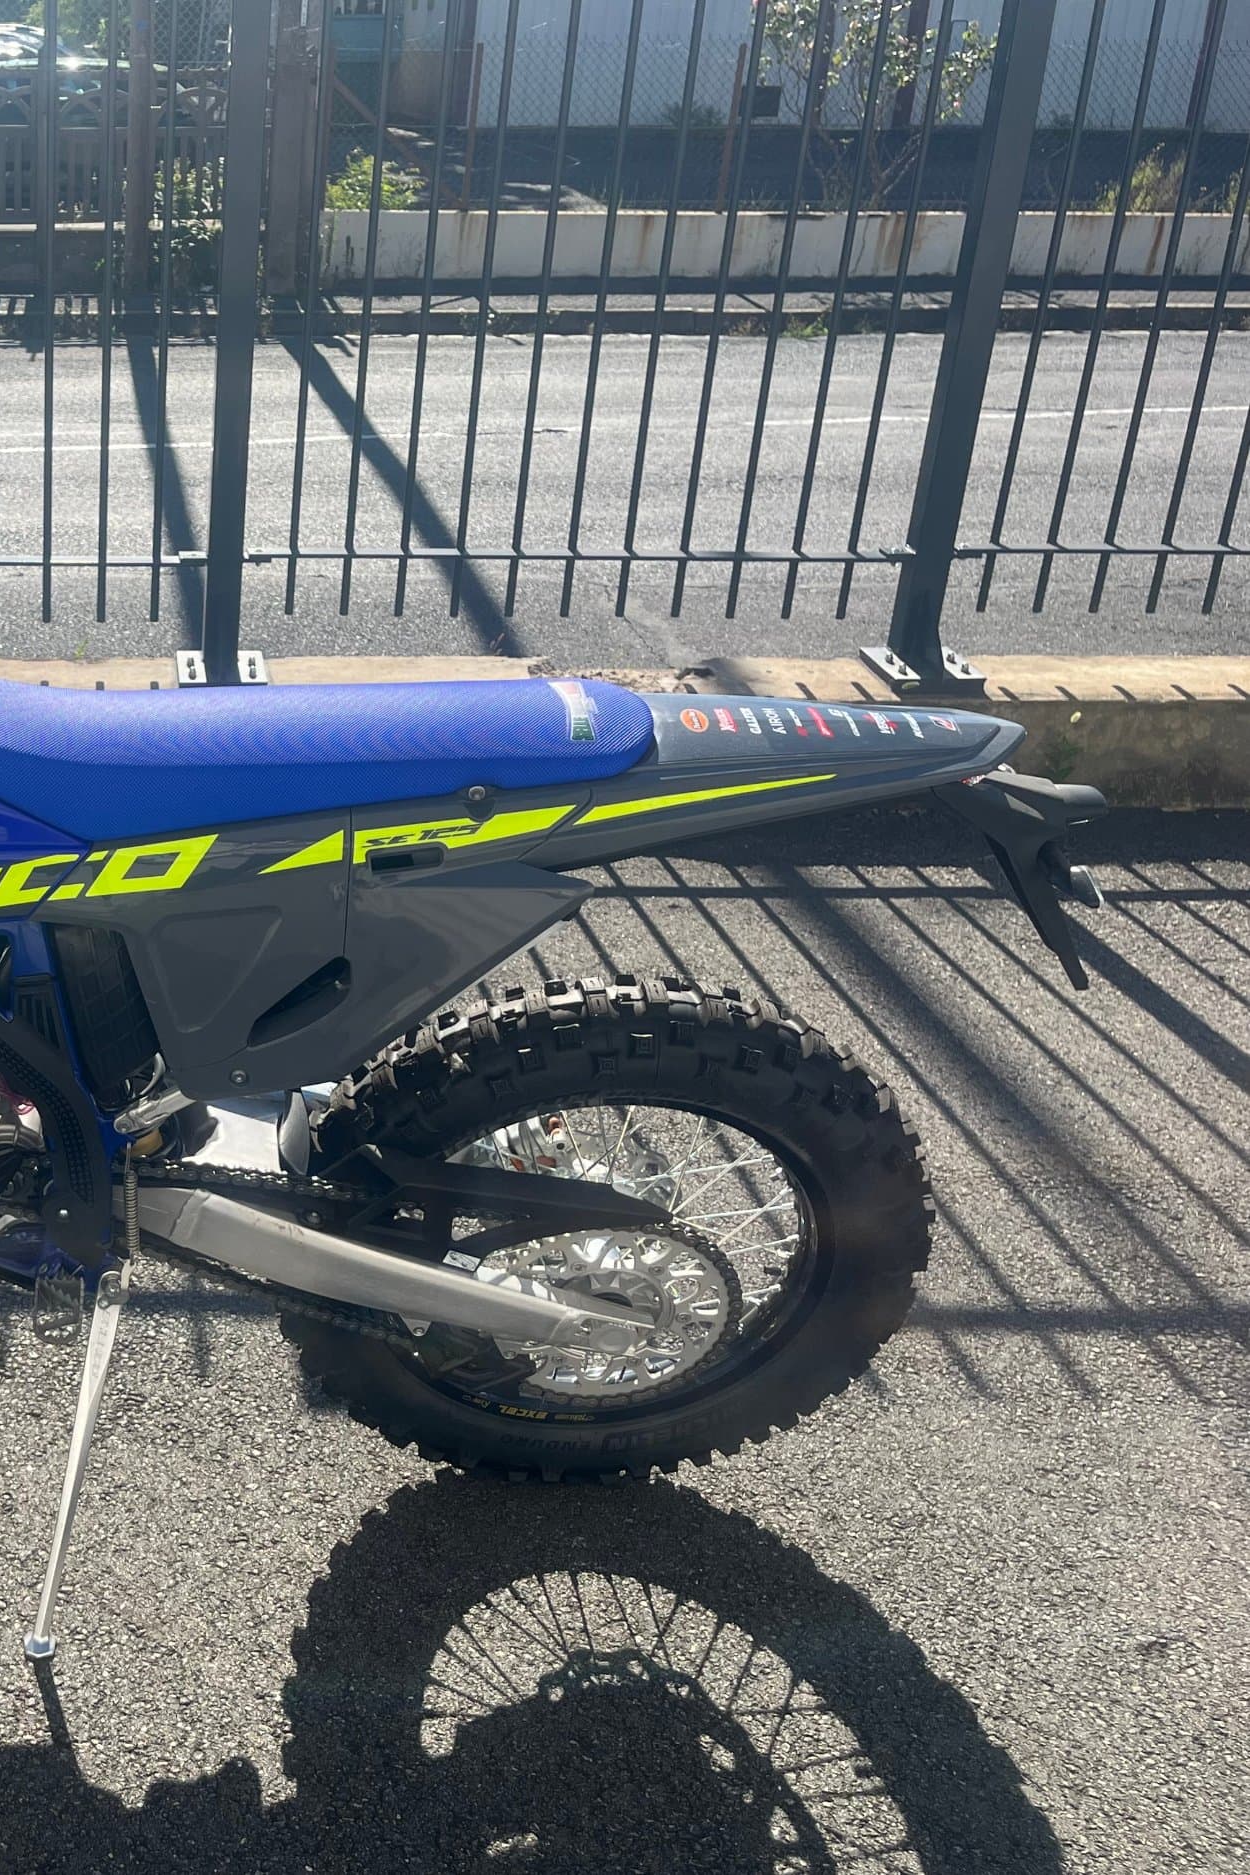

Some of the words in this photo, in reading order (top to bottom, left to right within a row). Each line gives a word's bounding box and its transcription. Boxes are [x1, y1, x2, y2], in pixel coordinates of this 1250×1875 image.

[362, 832, 416, 848] SE
[418, 822, 484, 842] 125
[499, 1404, 549, 1420] EXCEL
